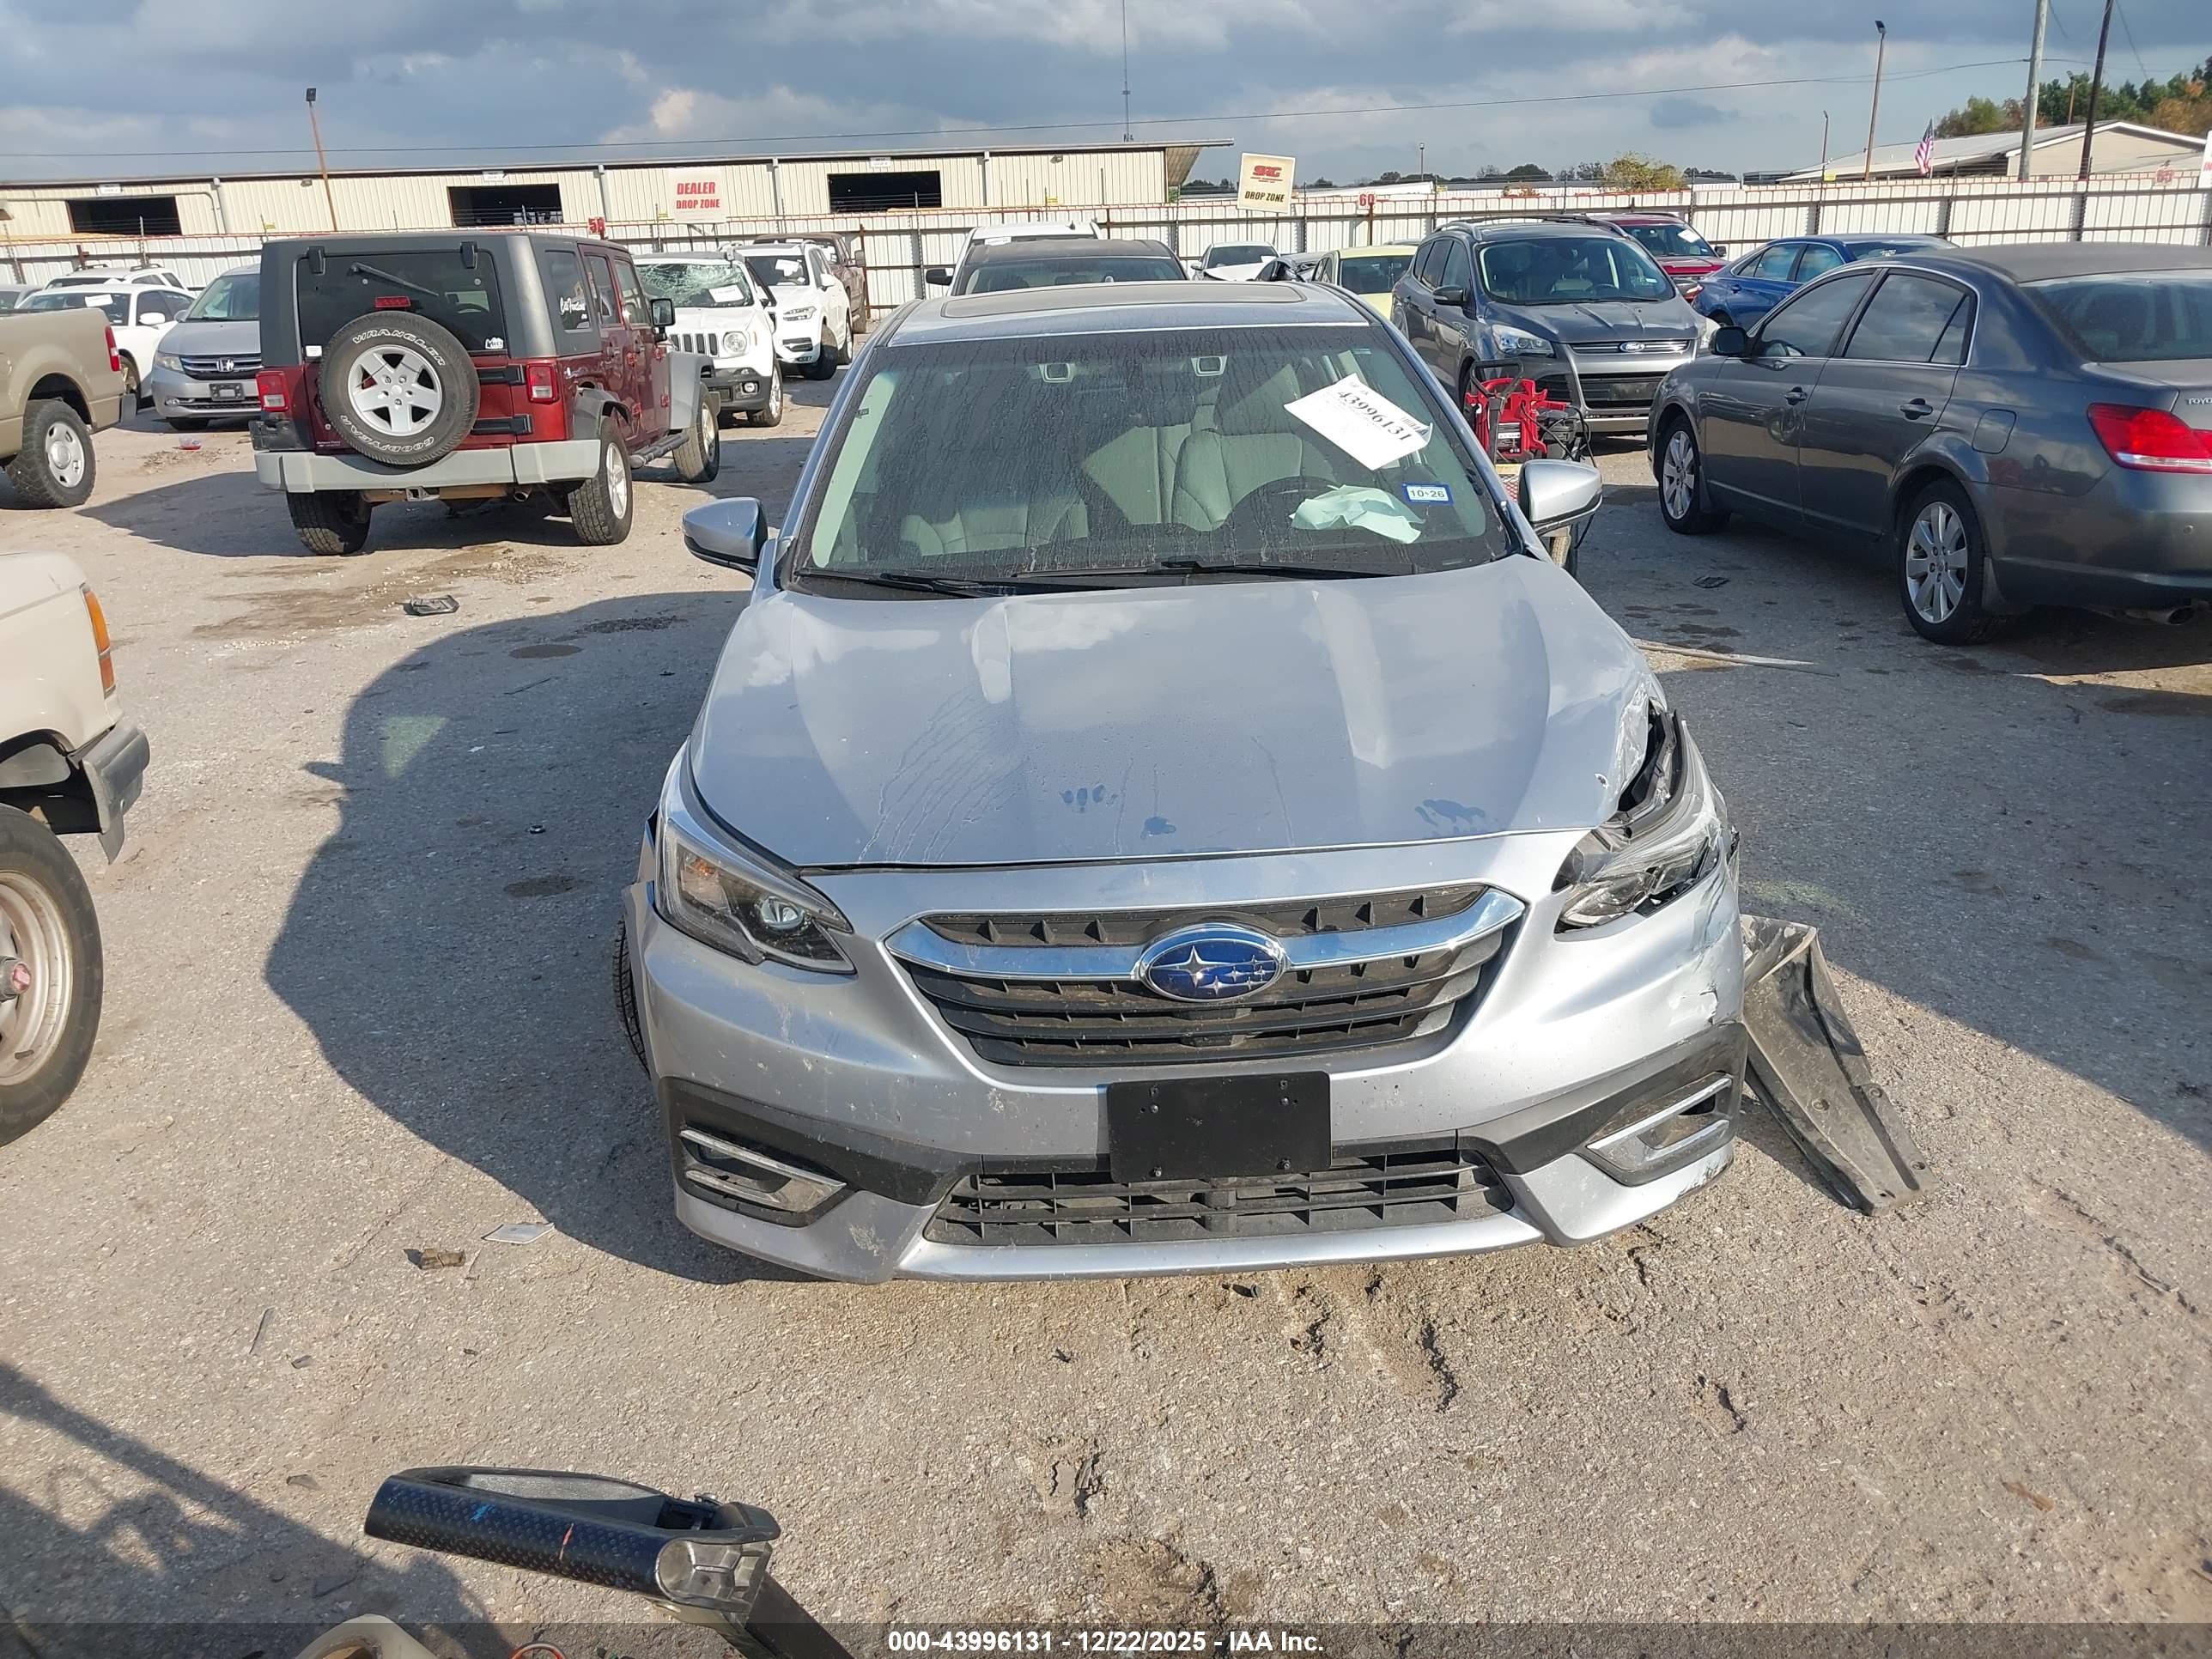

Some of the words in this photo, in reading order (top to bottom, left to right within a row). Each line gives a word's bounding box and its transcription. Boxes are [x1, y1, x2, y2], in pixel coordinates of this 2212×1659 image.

[677, 182, 715, 195] DEALER
[676, 200, 698, 209] DROP
[700, 199, 720, 209] ZONE
[1244, 191, 1265, 200] DROP
[1266, 193, 1285, 203] ZONE
[1359, 193, 1376, 207] 60
[352, 329, 447, 366] WRANGLER
[1337, 390, 1413, 441] 43996131
[340, 415, 435, 453] GOODYEAR
